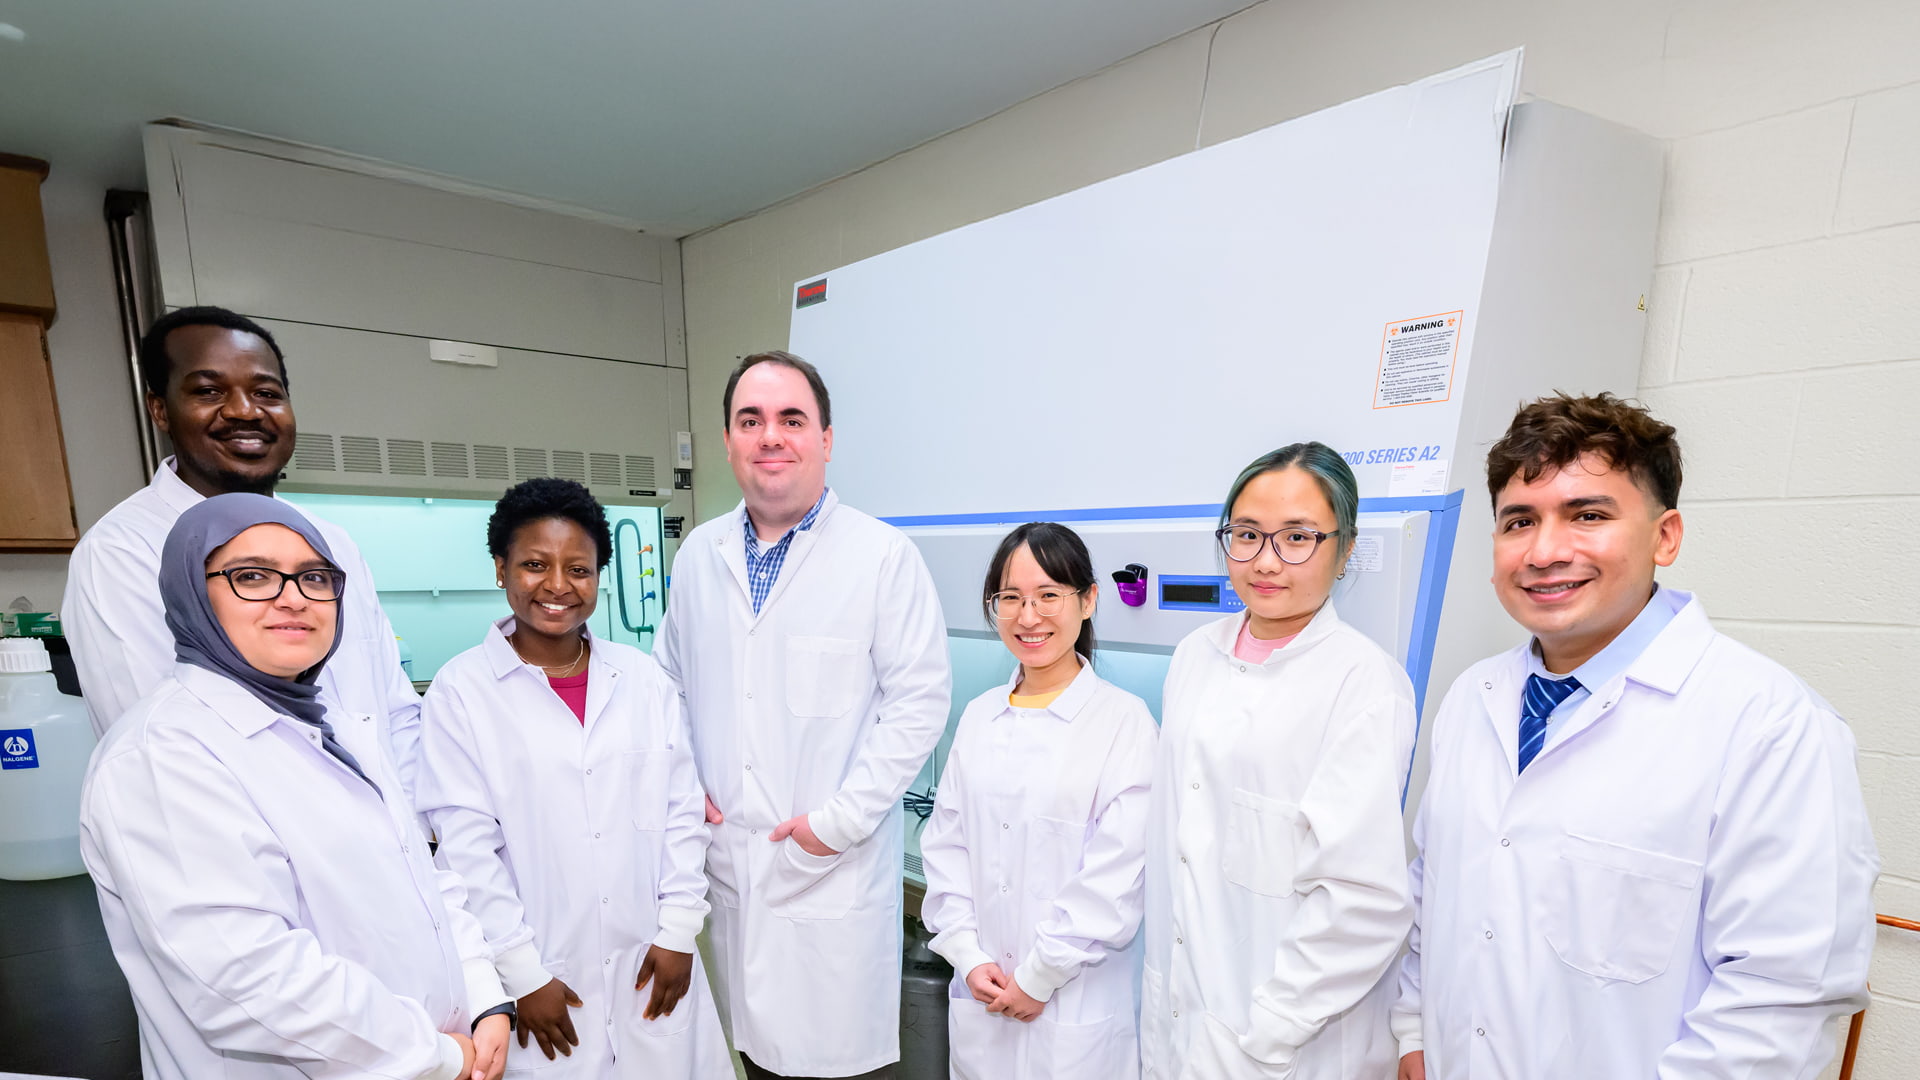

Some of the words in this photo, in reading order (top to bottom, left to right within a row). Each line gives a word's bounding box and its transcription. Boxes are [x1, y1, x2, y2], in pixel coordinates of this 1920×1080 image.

[1401, 320, 1444, 334] WARNING
[1338, 450, 1365, 466] 300
[1366, 446, 1417, 464] SERIES
[1418, 445, 1441, 461] A2
